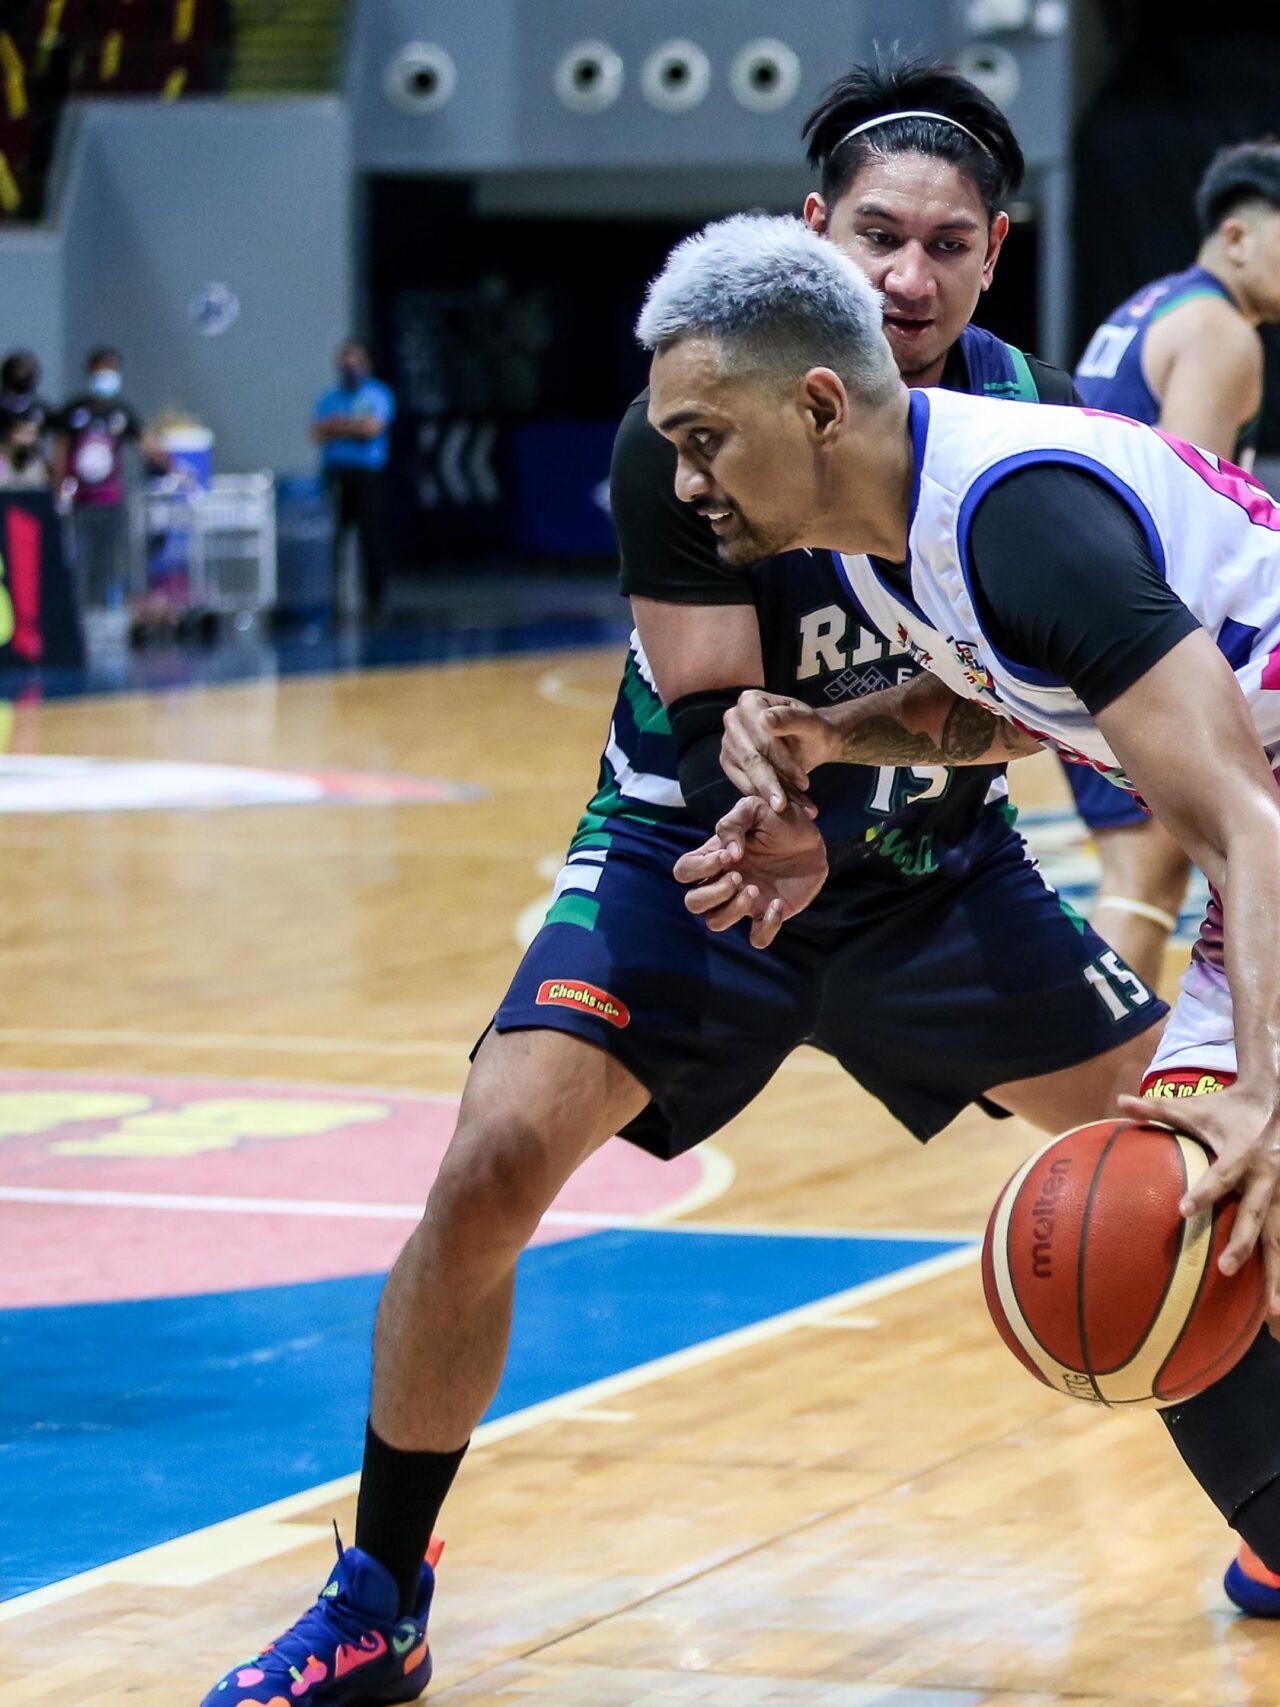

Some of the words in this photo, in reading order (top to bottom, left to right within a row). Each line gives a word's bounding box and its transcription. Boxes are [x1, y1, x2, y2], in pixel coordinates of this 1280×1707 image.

[548, 983, 597, 1008] Chooks
[1083, 949, 1151, 1022] 15
[1031, 1157, 1073, 1280] molten
